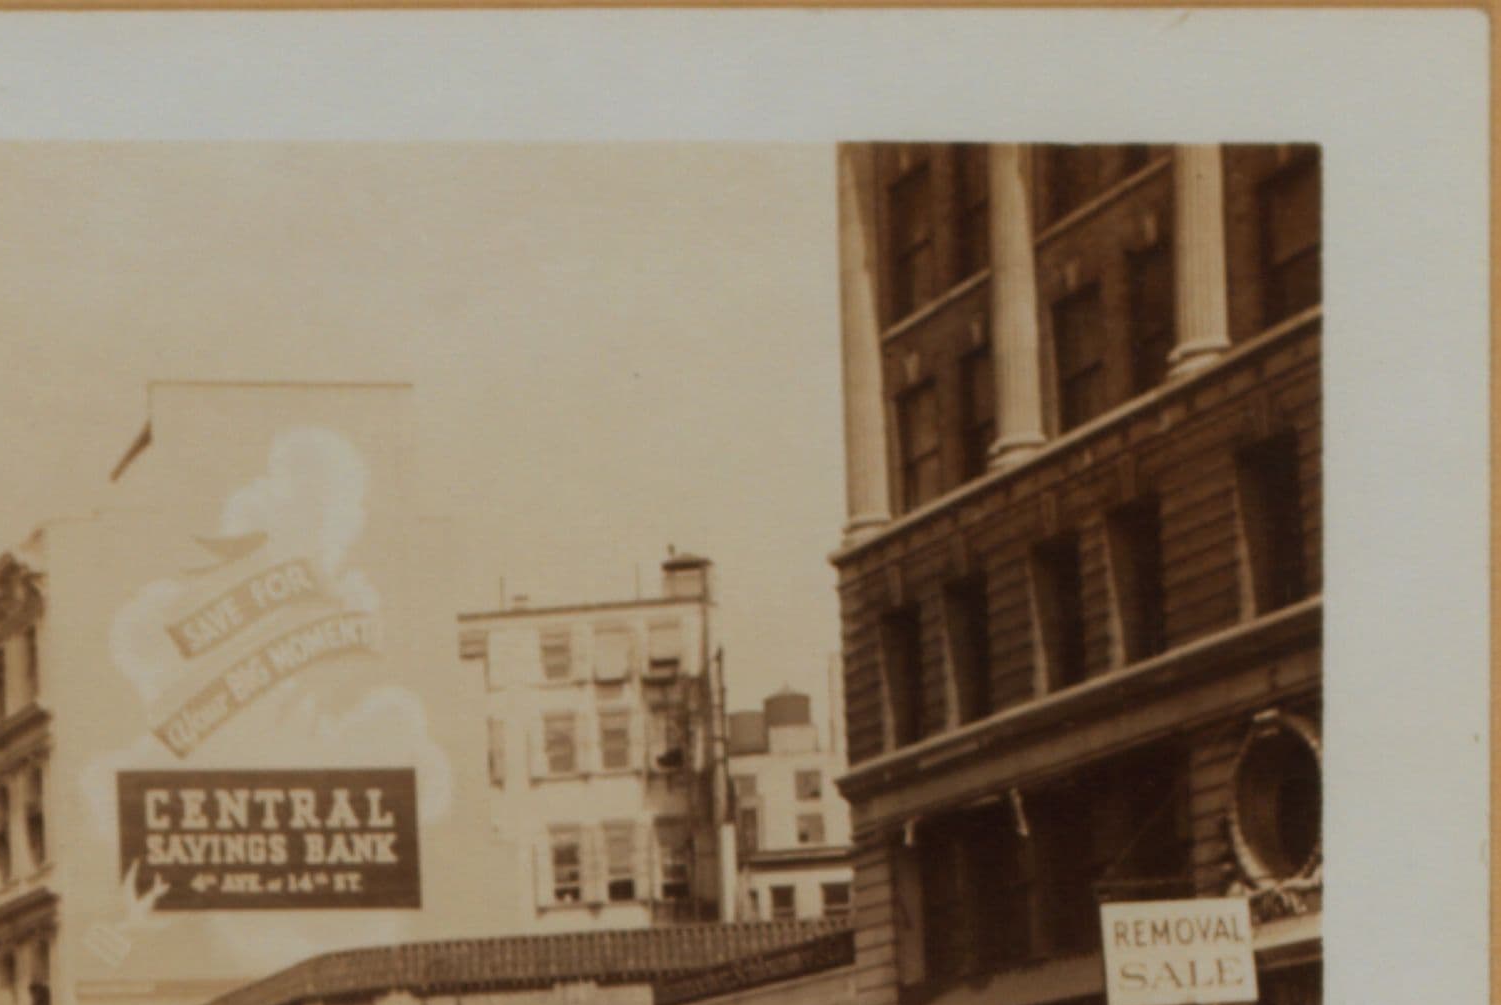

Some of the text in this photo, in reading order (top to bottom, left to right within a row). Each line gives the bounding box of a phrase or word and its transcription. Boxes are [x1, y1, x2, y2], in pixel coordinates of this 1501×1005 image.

[182, 564, 314, 654] SAVE FOR
[266, 614, 375, 675] MOMENT
[144, 788, 395, 830] CENTRAL
[146, 832, 398, 865] SAVINGS BANK
[1113, 914, 1245, 948] REMOVAL
[1118, 957, 1245, 990] SALE
